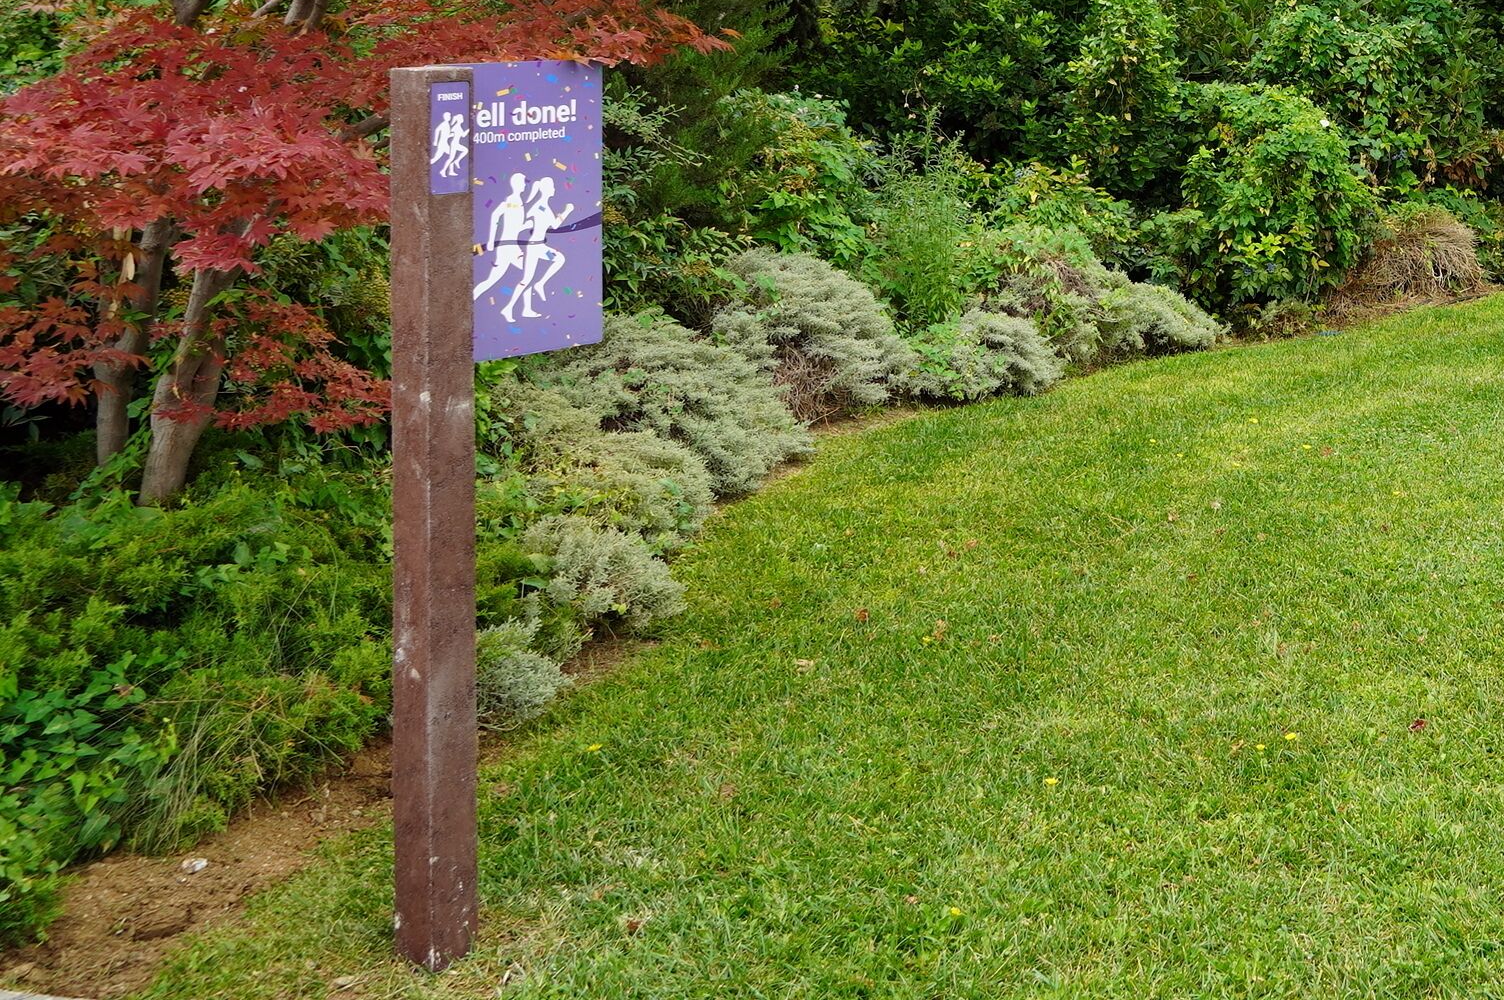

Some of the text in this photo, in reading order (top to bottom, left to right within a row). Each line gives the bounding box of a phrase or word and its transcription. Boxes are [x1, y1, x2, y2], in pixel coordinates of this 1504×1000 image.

[437, 92, 464, 102] FINISH
[475, 99, 577, 128] ell done!
[472, 126, 566, 144] 400m completed
